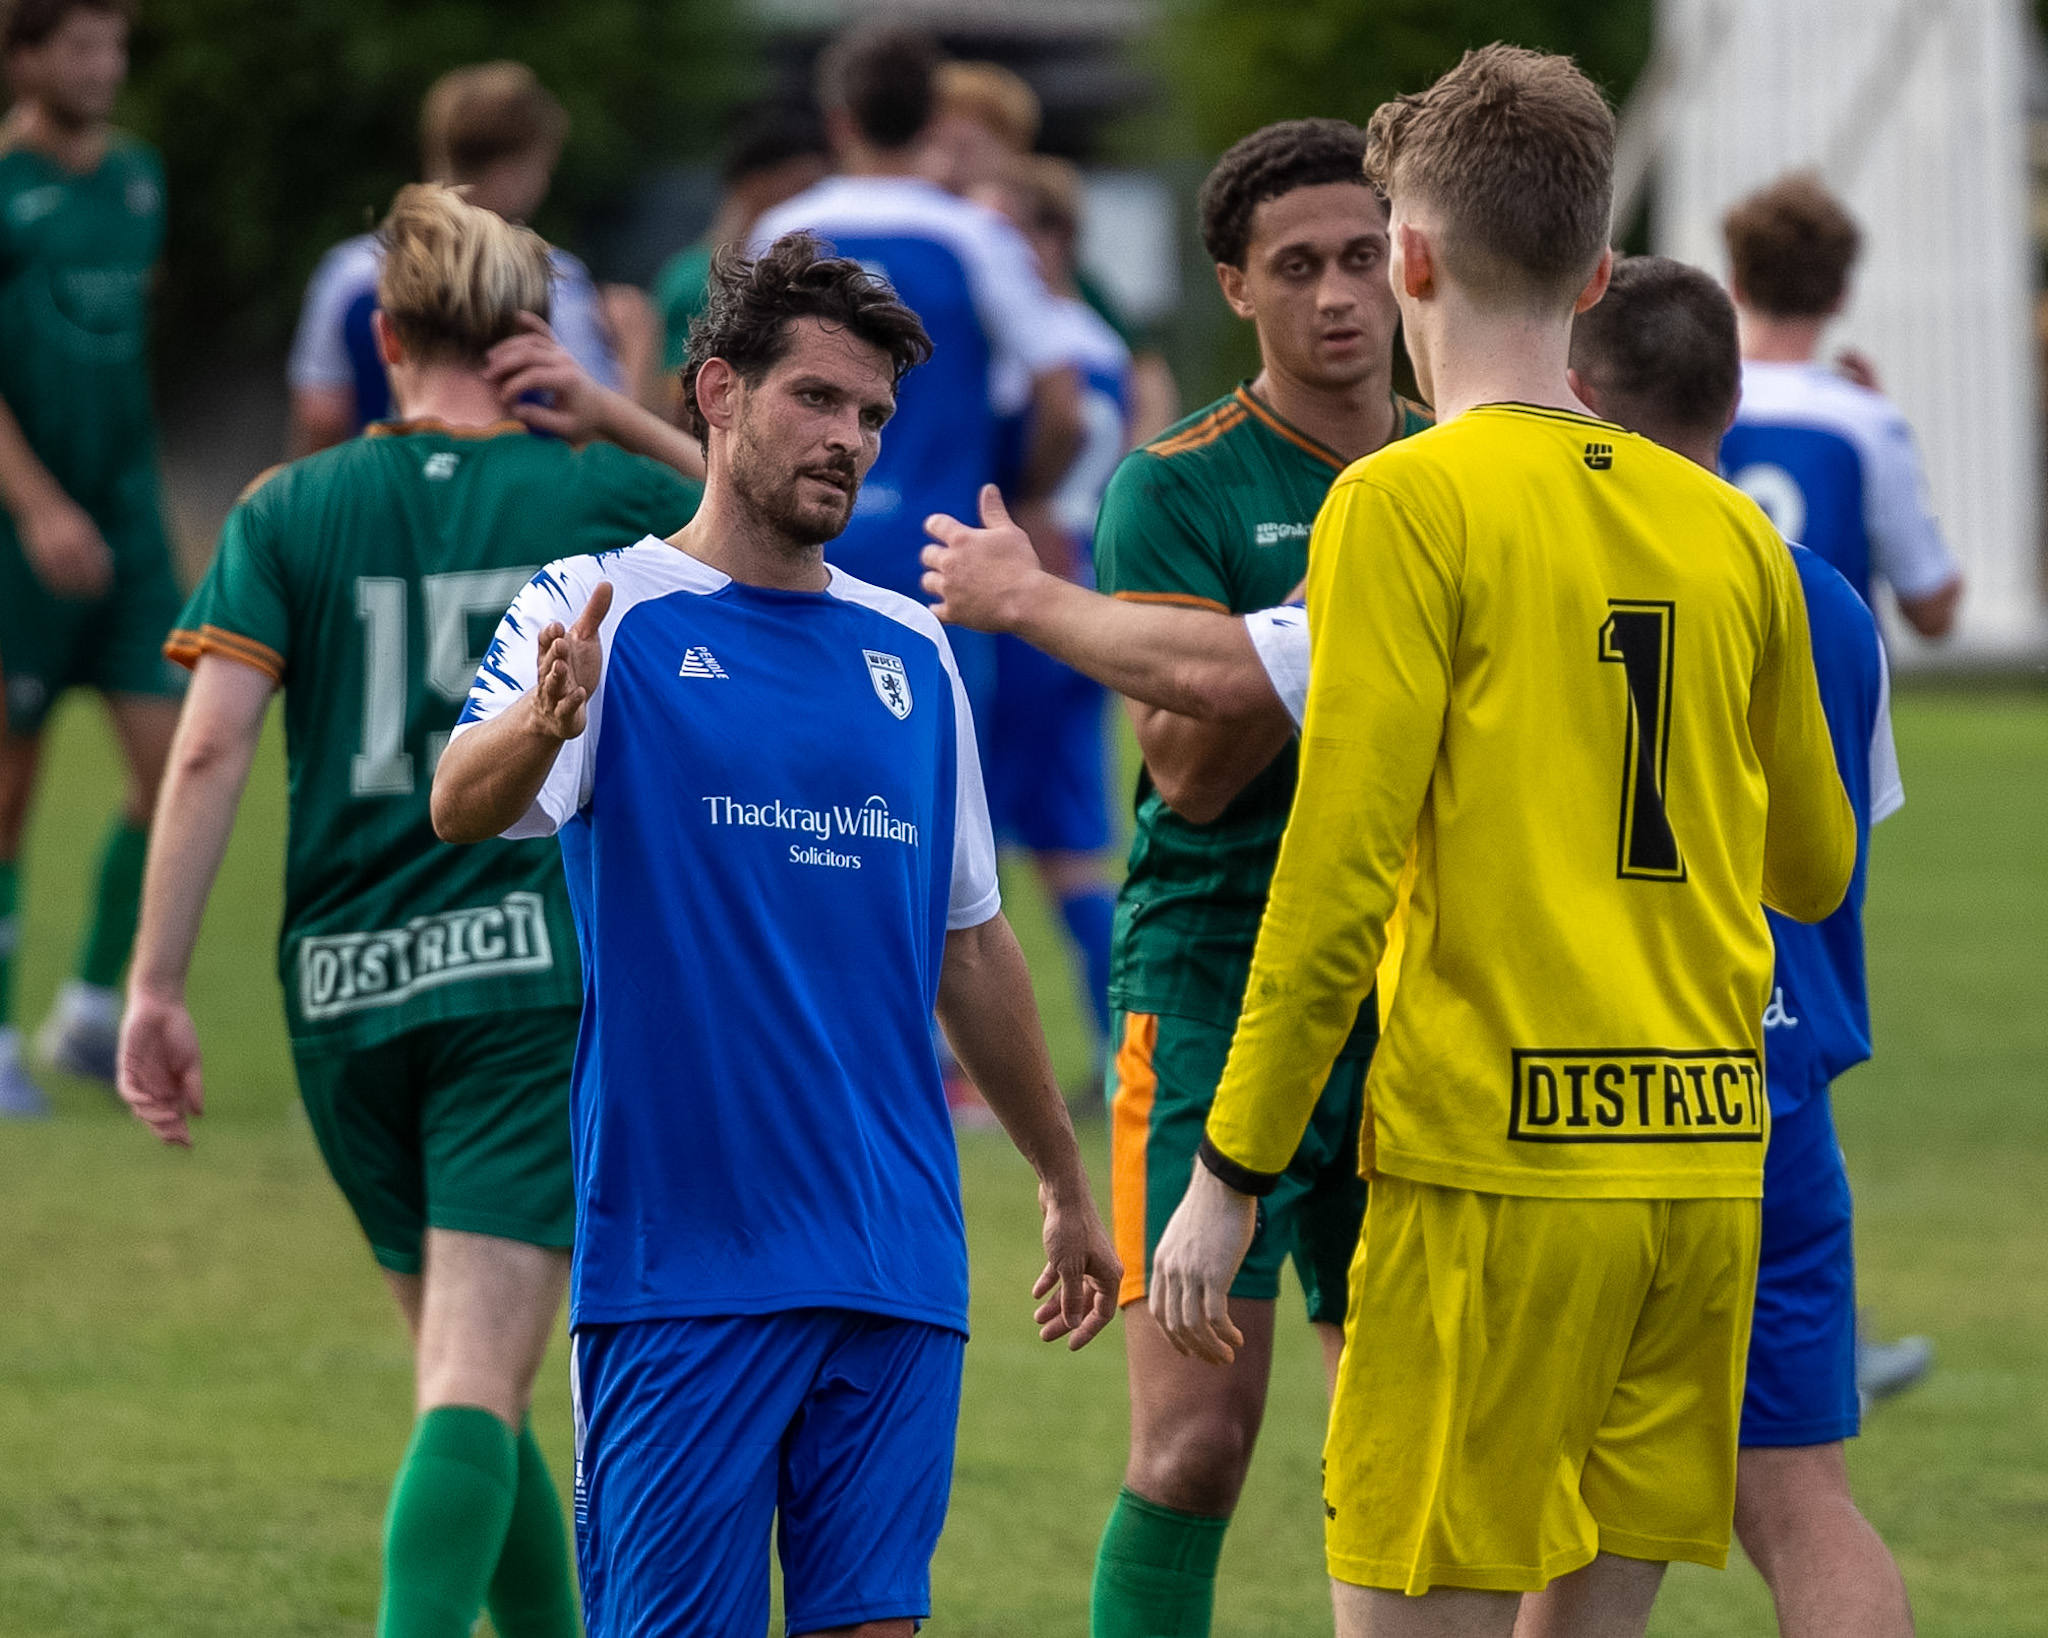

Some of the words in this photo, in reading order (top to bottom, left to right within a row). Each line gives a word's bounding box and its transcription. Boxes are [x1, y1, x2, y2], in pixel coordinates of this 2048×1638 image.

[693, 646, 730, 680] PENDLE
[1599, 598, 1687, 882] 1
[702, 796, 830, 841] Thackray
[789, 844, 861, 869] Solicitors
[311, 903, 532, 1003] DISTRICT
[1526, 1063, 1758, 1127] DISTRICT
